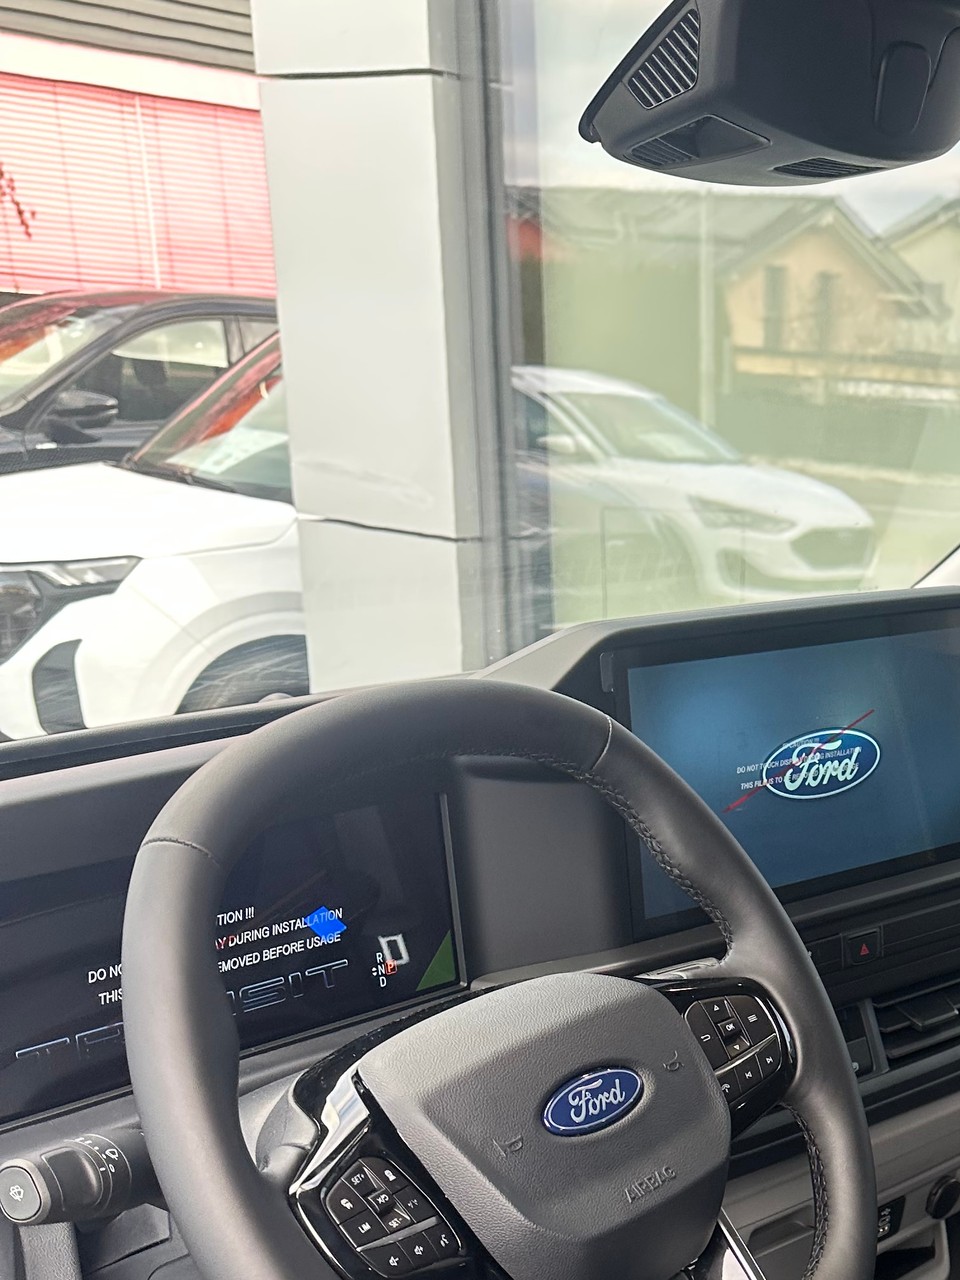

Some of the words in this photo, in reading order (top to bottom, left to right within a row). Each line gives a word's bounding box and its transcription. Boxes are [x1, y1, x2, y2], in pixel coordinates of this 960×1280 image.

[736, 765, 745, 774] DO
[746, 763, 758, 772] NOT
[825, 745, 862, 758] INSTALLATN
[784, 740, 861, 791] Ford
[740, 780, 753, 790] THIS
[753, 778, 767, 788] FIL
[774, 775, 782, 784] TO
[245, 906, 255, 920] !!!
[88, 968, 107, 984] DO
[228, 926, 270, 948] DURING
[272, 907, 343, 936] INSTALLATION
[217, 951, 261, 973] EMOVED
[262, 940, 305, 962] BEFORE
[306, 930, 341, 949] USAGE
[376, 952, 384, 964] R
[377, 964, 386, 976] N
[379, 976, 387, 988] D
[725, 1023, 736, 1032] OK
[567, 1078, 627, 1123] Ford
[623, 1165, 677, 1204] AIRBAG
